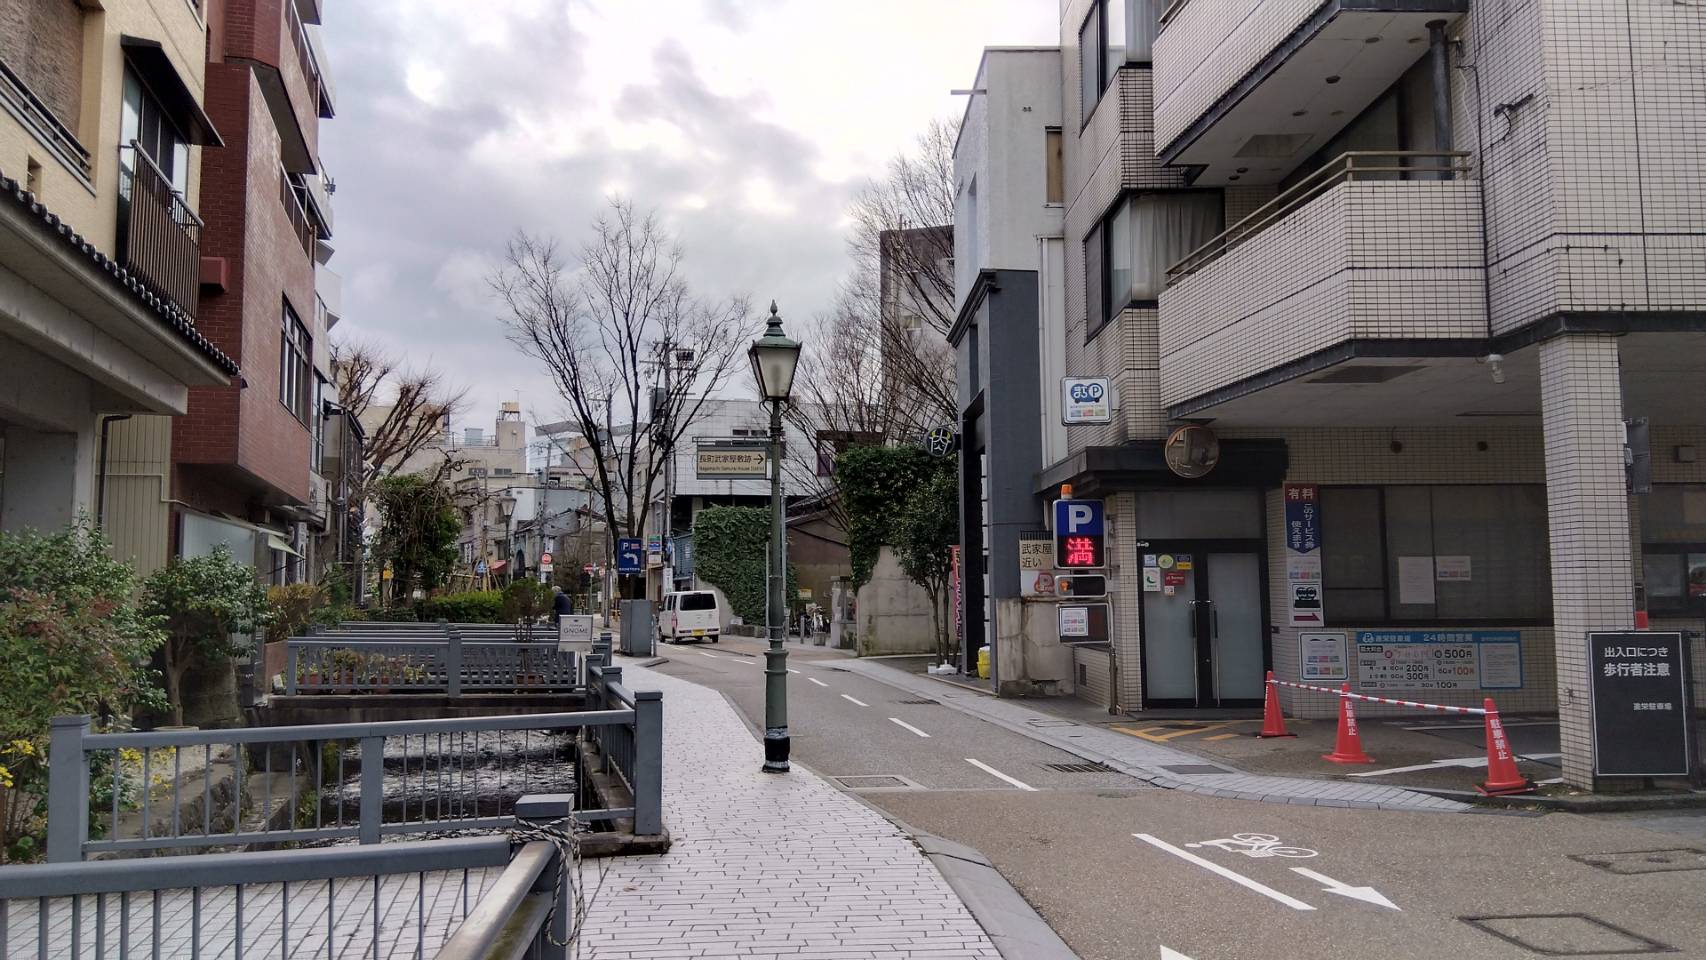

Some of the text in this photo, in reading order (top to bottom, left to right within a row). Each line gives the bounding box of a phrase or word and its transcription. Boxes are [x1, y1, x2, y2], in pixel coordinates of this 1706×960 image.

[700, 454, 752, 464] 長町武家屋敷跡
[1288, 487, 1314, 500] 有料
[1068, 504, 1093, 533] P
[1303, 503, 1314, 549] このサービス券
[1291, 520, 1303, 548] 使えます
[623, 542, 630, 551] P
[1022, 543, 1053, 555] 武家屋
[1067, 537, 1093, 565] 満
[1022, 557, 1042, 568] 近い
[1423, 633, 1472, 642] 24時間営業
[1444, 649, 1472, 658] 500円
[1604, 646, 1668, 658] 出入口につき
[1604, 662, 1670, 677] 歩行者注意
[1633, 702, 1672, 711] 進栄駐車場
[1345, 701, 1357, 736] 駐車禁止
[1490, 719, 1509, 760] 駐車禁止
